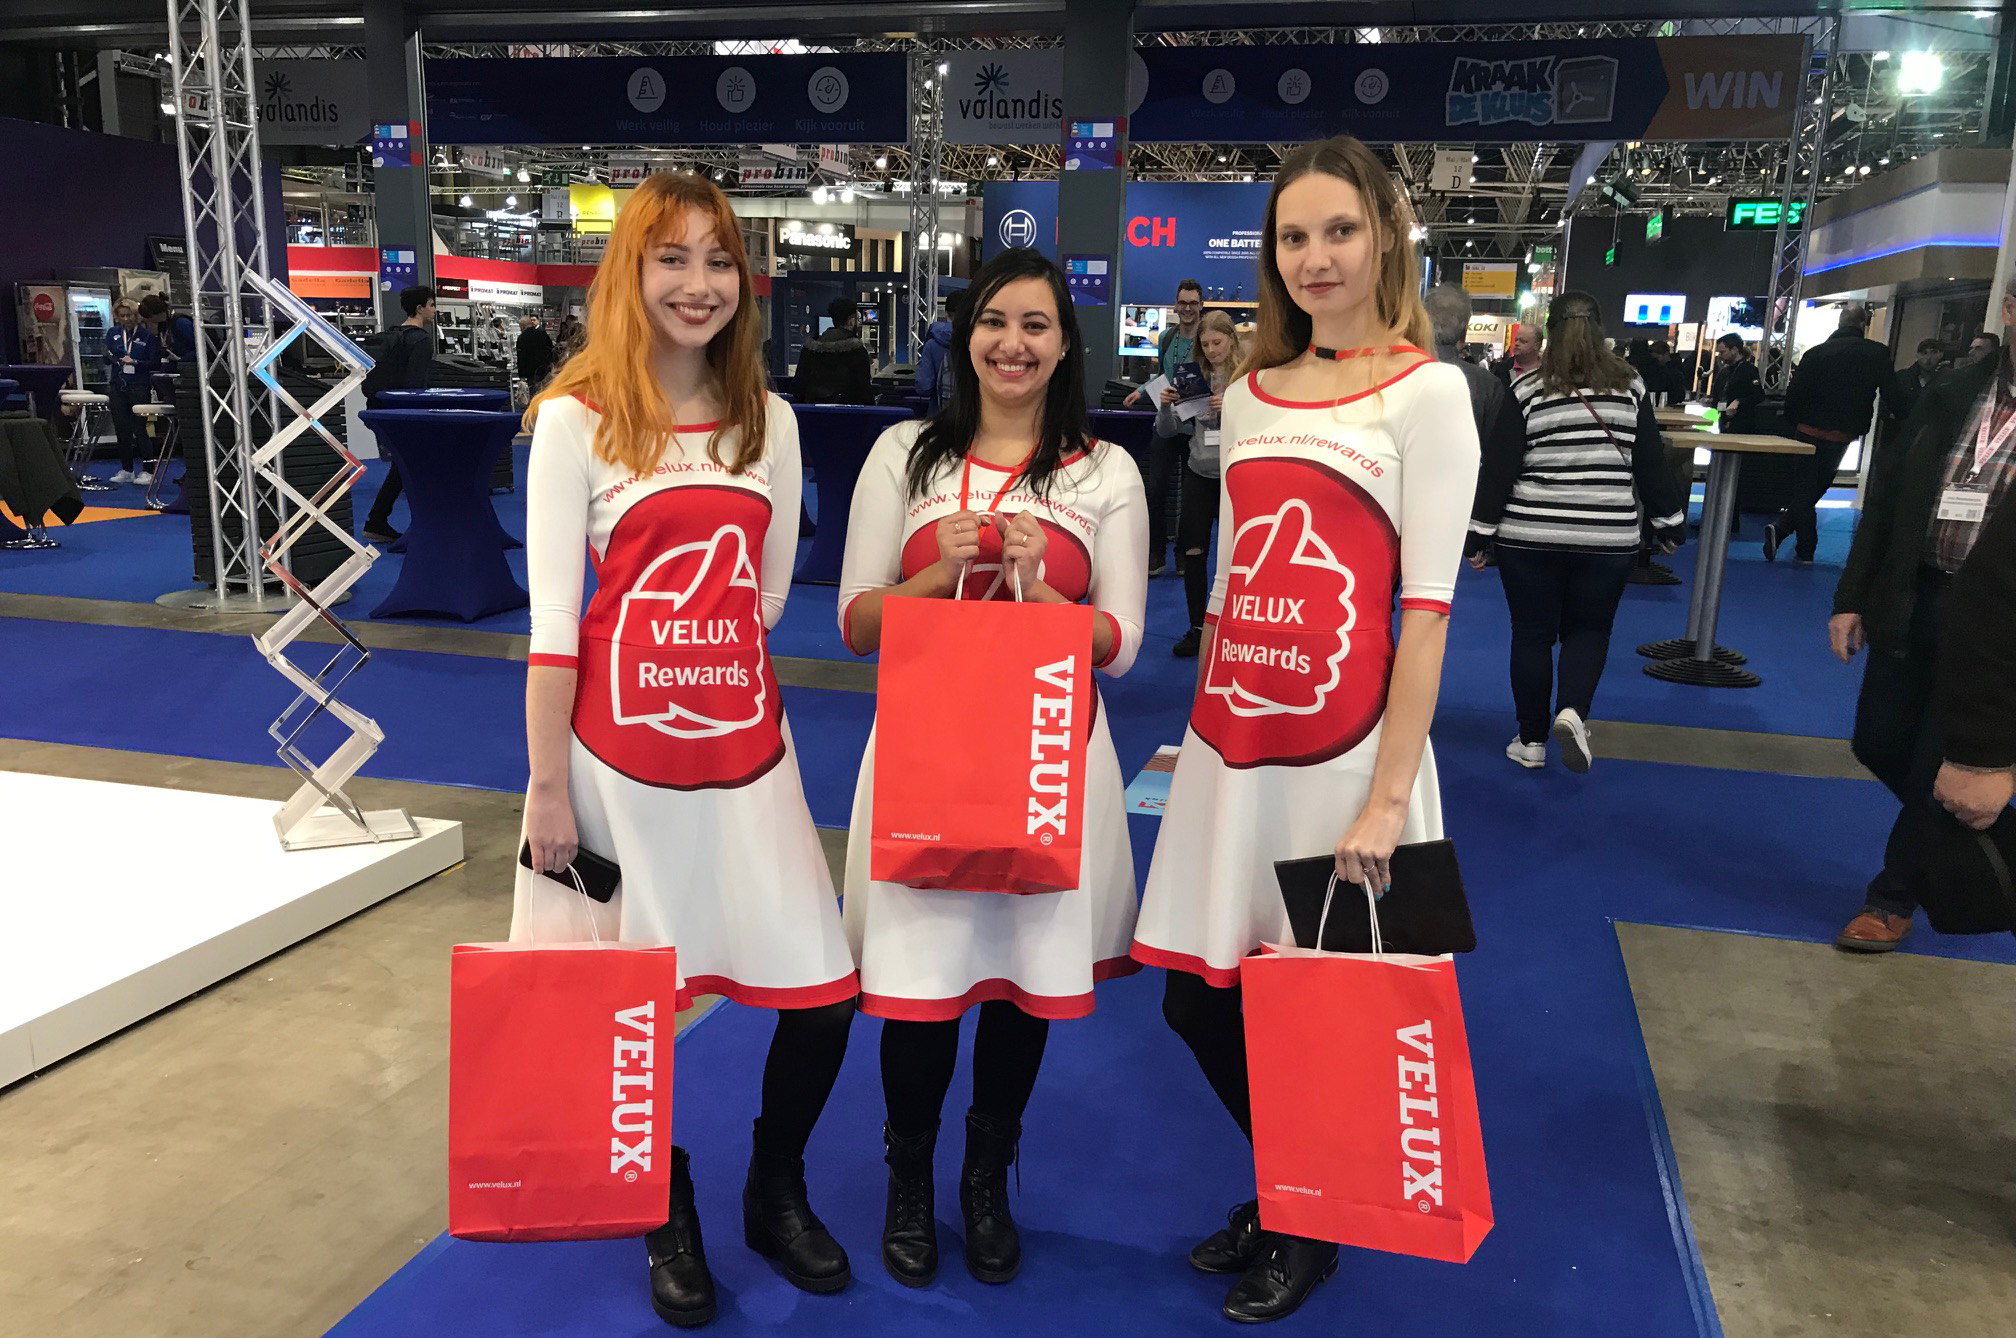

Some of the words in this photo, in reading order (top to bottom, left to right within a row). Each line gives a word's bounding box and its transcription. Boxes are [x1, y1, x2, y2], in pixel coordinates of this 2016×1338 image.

[1452, 58, 1550, 92] KRAAK
[1684, 70, 1783, 110] WIN
[959, 89, 1063, 120] volandis
[1449, 94, 1478, 124] DE
[1480, 92, 1552, 125] KLUIS
[615, 119, 647, 131] Werk
[650, 119, 681, 133] veilig
[700, 119, 731, 132] Houd
[735, 119, 775, 133] plezier
[795, 118, 818, 132] Kijk
[820, 119, 865, 131] vooruit
[741, 161, 806, 182] probin
[1451, 175, 1462, 189] D
[158, 243, 184, 254] Menu
[779, 227, 851, 249] Panasonic
[1208, 238, 1230, 248] ONE
[1231, 238, 1263, 248] BATTE
[1535, 246, 1553, 254] bott
[1228, 433, 1384, 478] .velux.nl/rewards
[909, 489, 1092, 536] www.velu.nl/rewards
[1232, 594, 1306, 625] VELUX
[650, 618, 740, 645] VELUX
[1221, 638, 1311, 675] Rewards
[638, 660, 749, 689] Rewards
[890, 831, 941, 842] www.velux.nl
[468, 1179, 522, 1190] www.velux.nl
[1274, 1183, 1322, 1197] www.velux.nl
